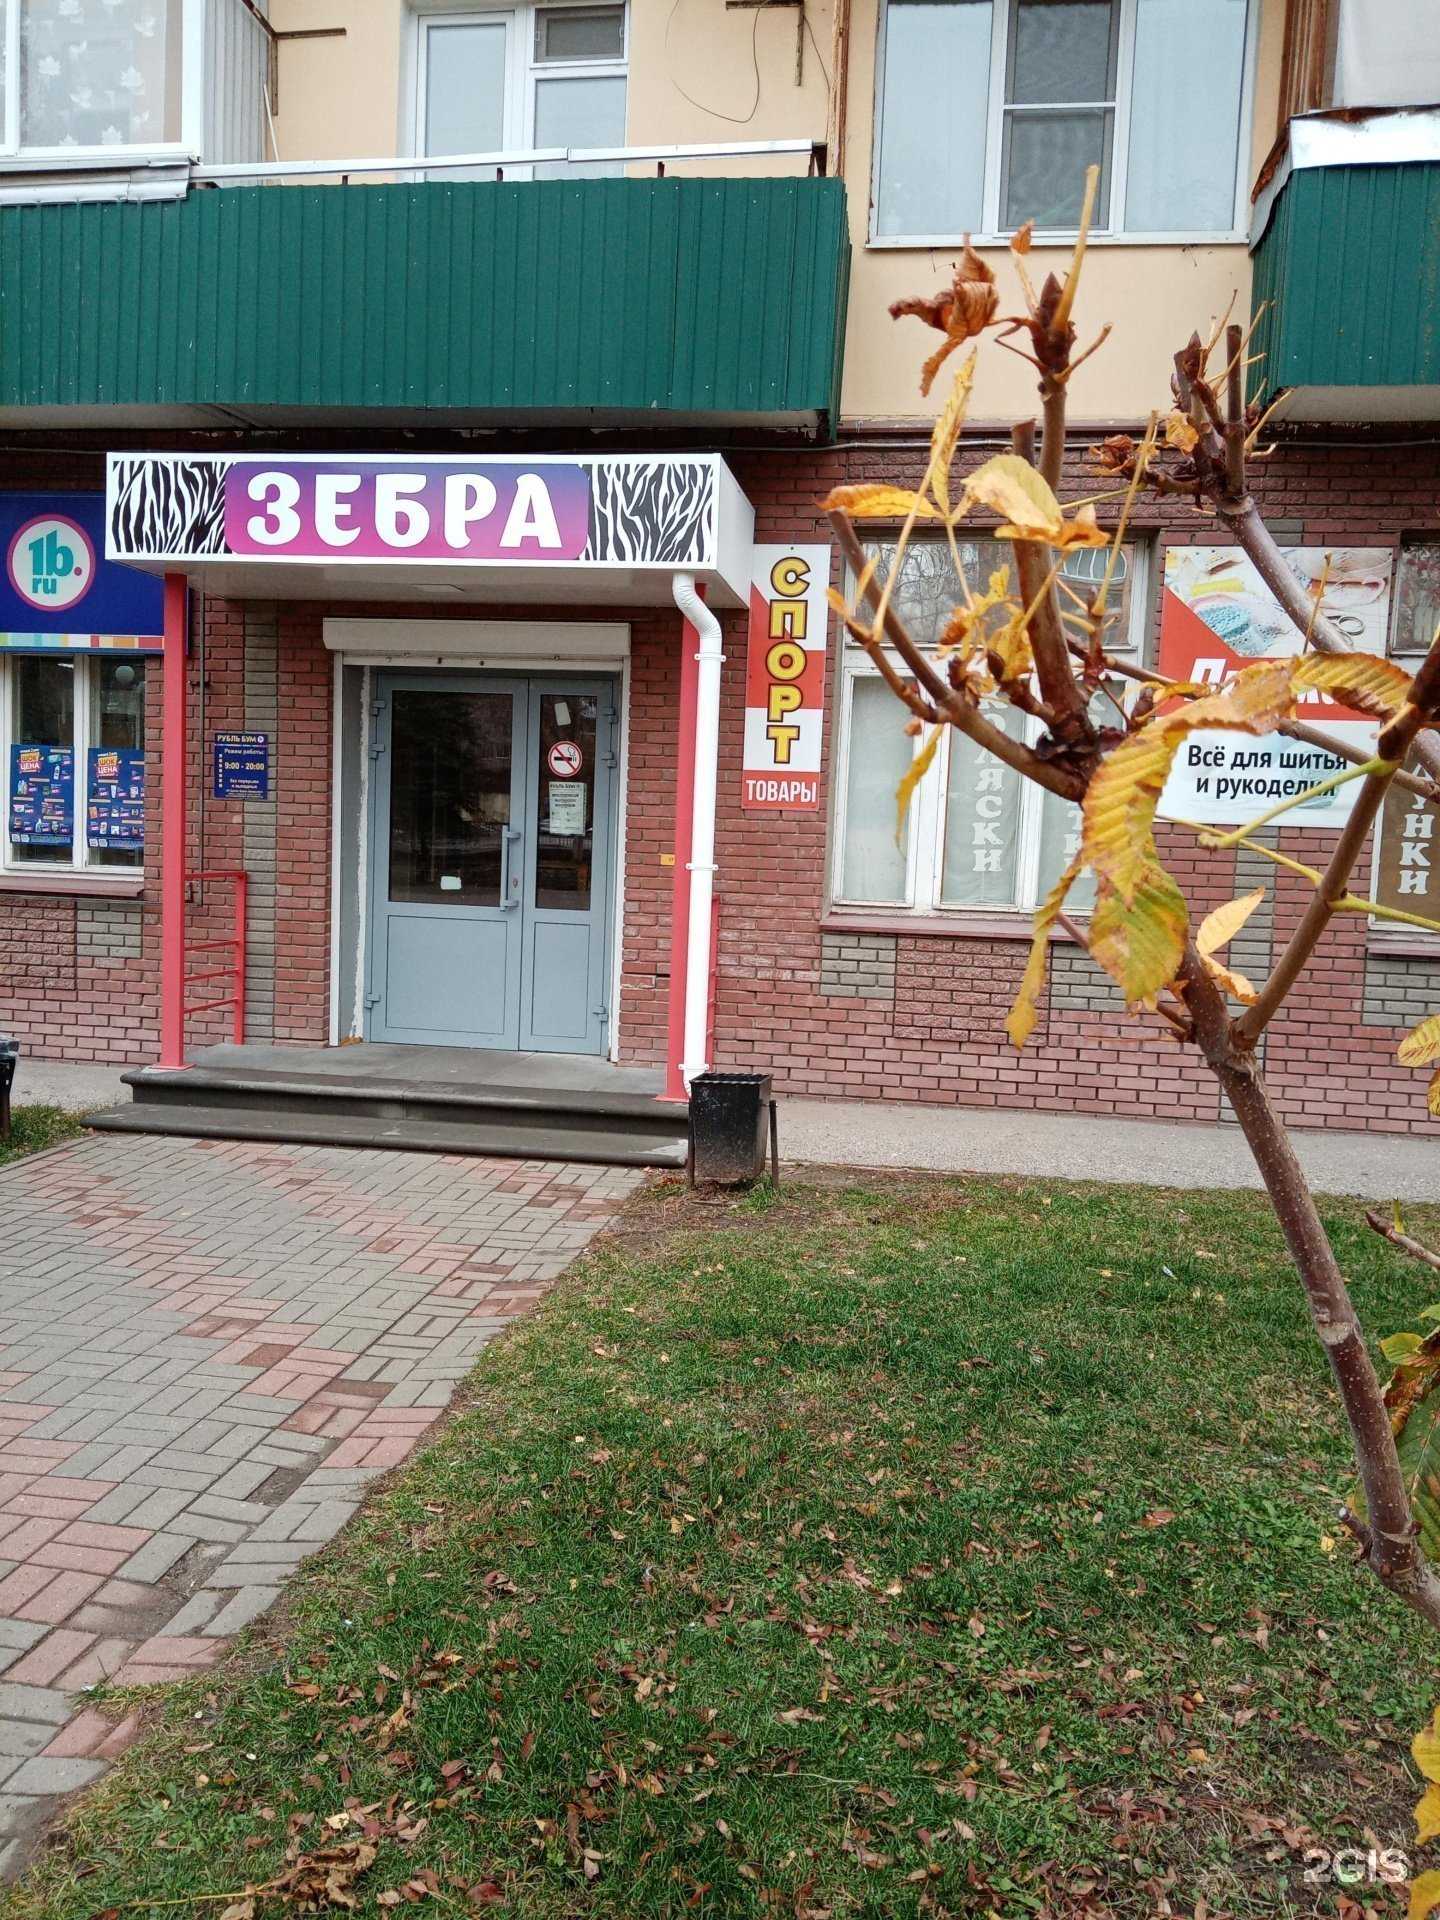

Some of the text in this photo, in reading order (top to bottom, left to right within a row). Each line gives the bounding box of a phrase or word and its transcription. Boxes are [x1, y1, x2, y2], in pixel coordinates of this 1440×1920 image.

[247, 471, 563, 549] ЗЕБРА
[32, 578, 57, 594] ru
[765, 556, 811, 764] СПОРТ
[217, 735, 257, 743] РУБЛЬ БУМ
[1188, 744, 1347, 770] Всё для шитья
[20, 762, 40, 771] ЦЕНА
[98, 766, 118, 775] ЦЕНА
[245, 762, 265, 770] 20:00
[746, 779, 817, 803] ТОВАРЫ
[1196, 777, 1209, 793] и
